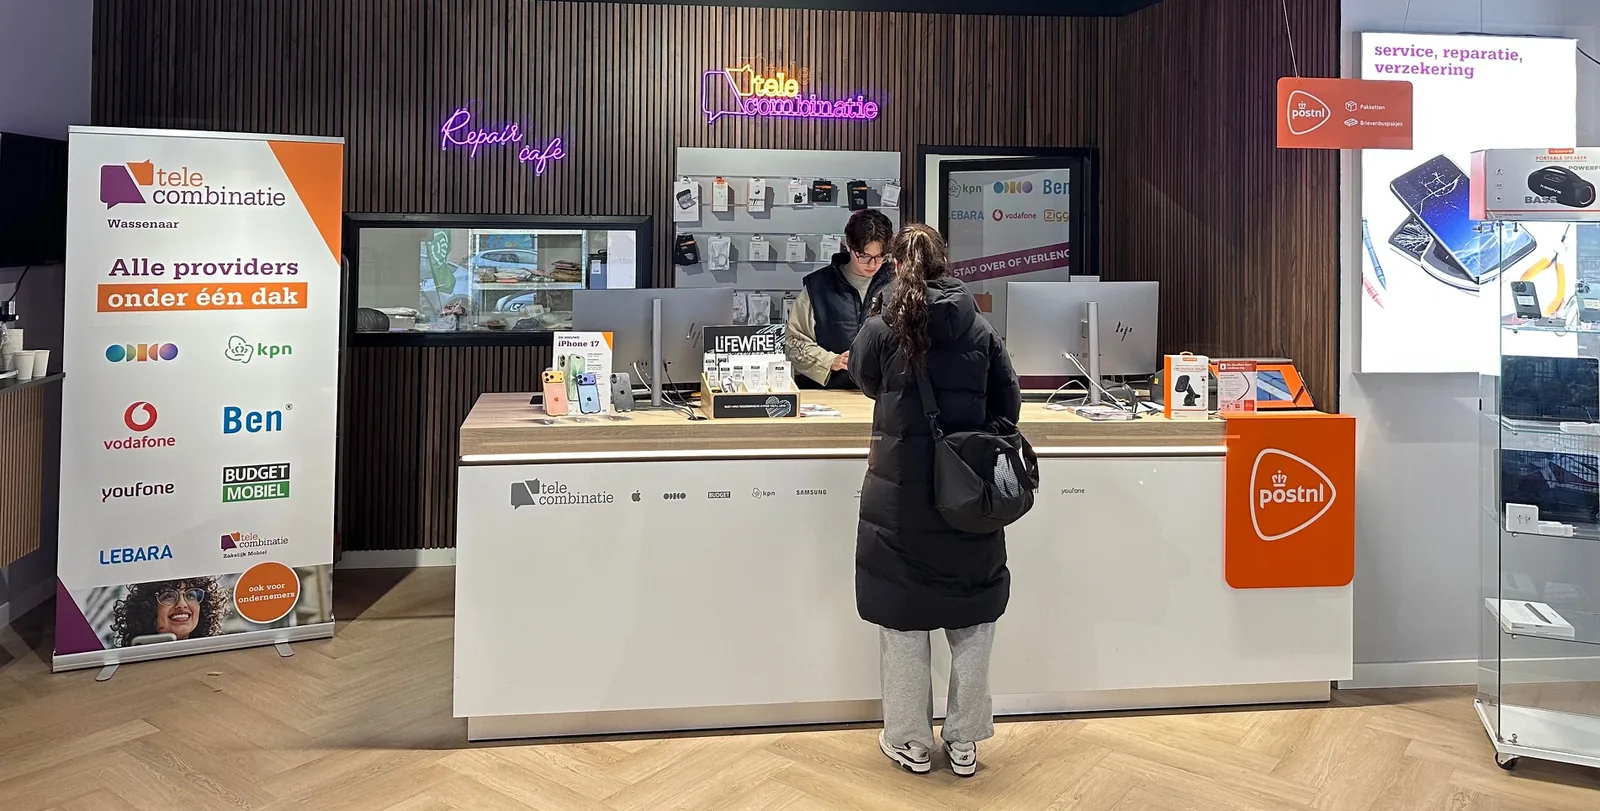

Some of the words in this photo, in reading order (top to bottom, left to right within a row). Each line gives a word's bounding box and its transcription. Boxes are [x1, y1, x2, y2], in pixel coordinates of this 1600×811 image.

[1374, 44, 1438, 60] service,
[1442, 46, 1523, 63] reparatie,
[1374, 62, 1475, 79] verzekering
[753, 73, 799, 96] tele
[745, 94, 878, 118] combinatie
[1292, 108, 1324, 120] postnl
[441, 108, 523, 158] Repair
[519, 138, 566, 174] cafe
[156, 166, 203, 187] tele
[153, 186, 286, 206] combinatie
[962, 184, 982, 194] kpn
[107, 219, 180, 229] Wassenaar
[948, 210, 984, 220] EBARA
[1005, 211, 1036, 220] vodafone
[108, 258, 164, 277] Alle
[173, 258, 299, 280] providers
[954, 266, 977, 278] STAP
[980, 260, 1006, 272] OVER
[1008, 257, 1022, 268] OF
[108, 290, 188, 308] onder
[196, 287, 244, 307] één
[252, 286, 298, 306] dak
[258, 342, 292, 358] kpn
[223, 406, 282, 434] Ben
[104, 435, 176, 450] vodafone
[225, 464, 288, 482] BUDGET
[102, 482, 175, 502] youfone
[226, 483, 285, 500] MOBIEL
[541, 482, 567, 494] tele
[1259, 482, 1324, 509] postnl
[539, 491, 614, 505] combinatie
[239, 537, 288, 548] combinatie
[241, 533, 258, 541] tele
[100, 544, 173, 565] LEBARA
[238, 592, 295, 603] ondernemers
